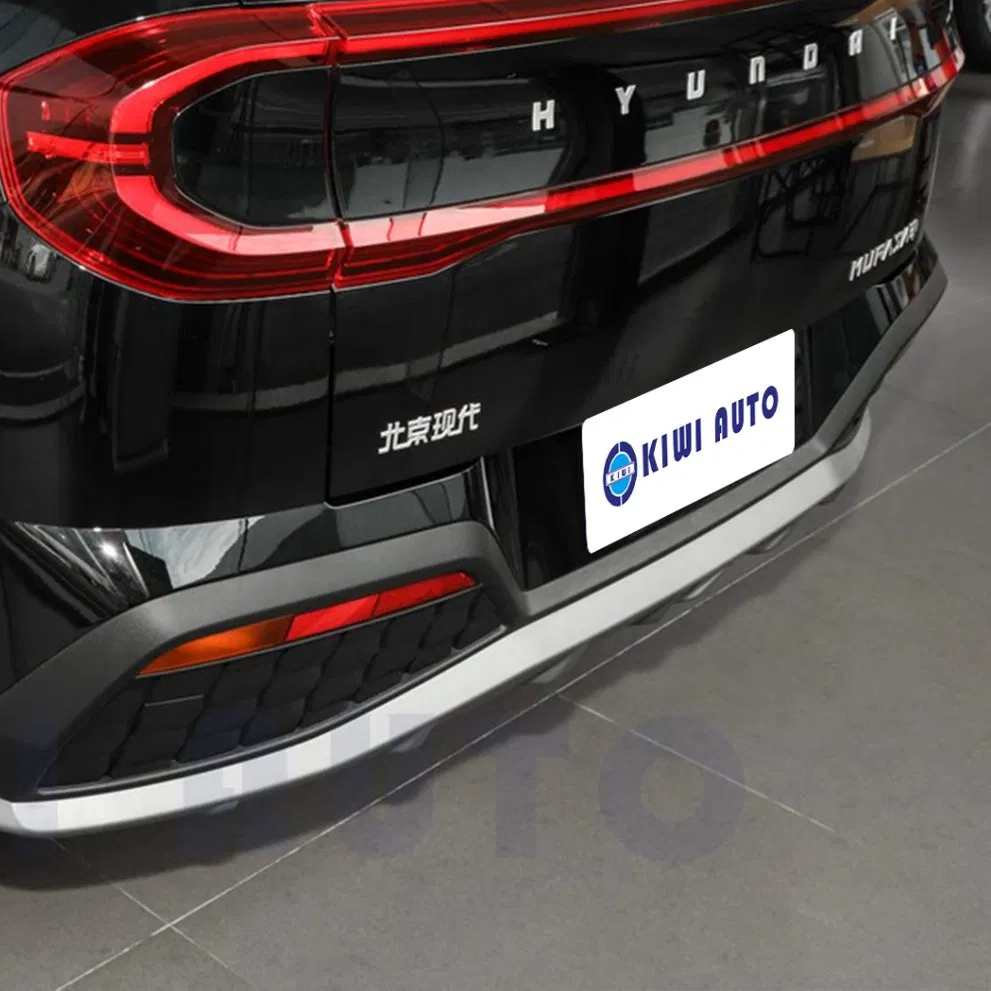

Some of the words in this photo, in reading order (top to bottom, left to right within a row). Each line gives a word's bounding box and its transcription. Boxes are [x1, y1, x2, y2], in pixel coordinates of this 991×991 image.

[531, 17, 898, 131] HYUNDAI
[378, 402, 482, 454] 北京现代
